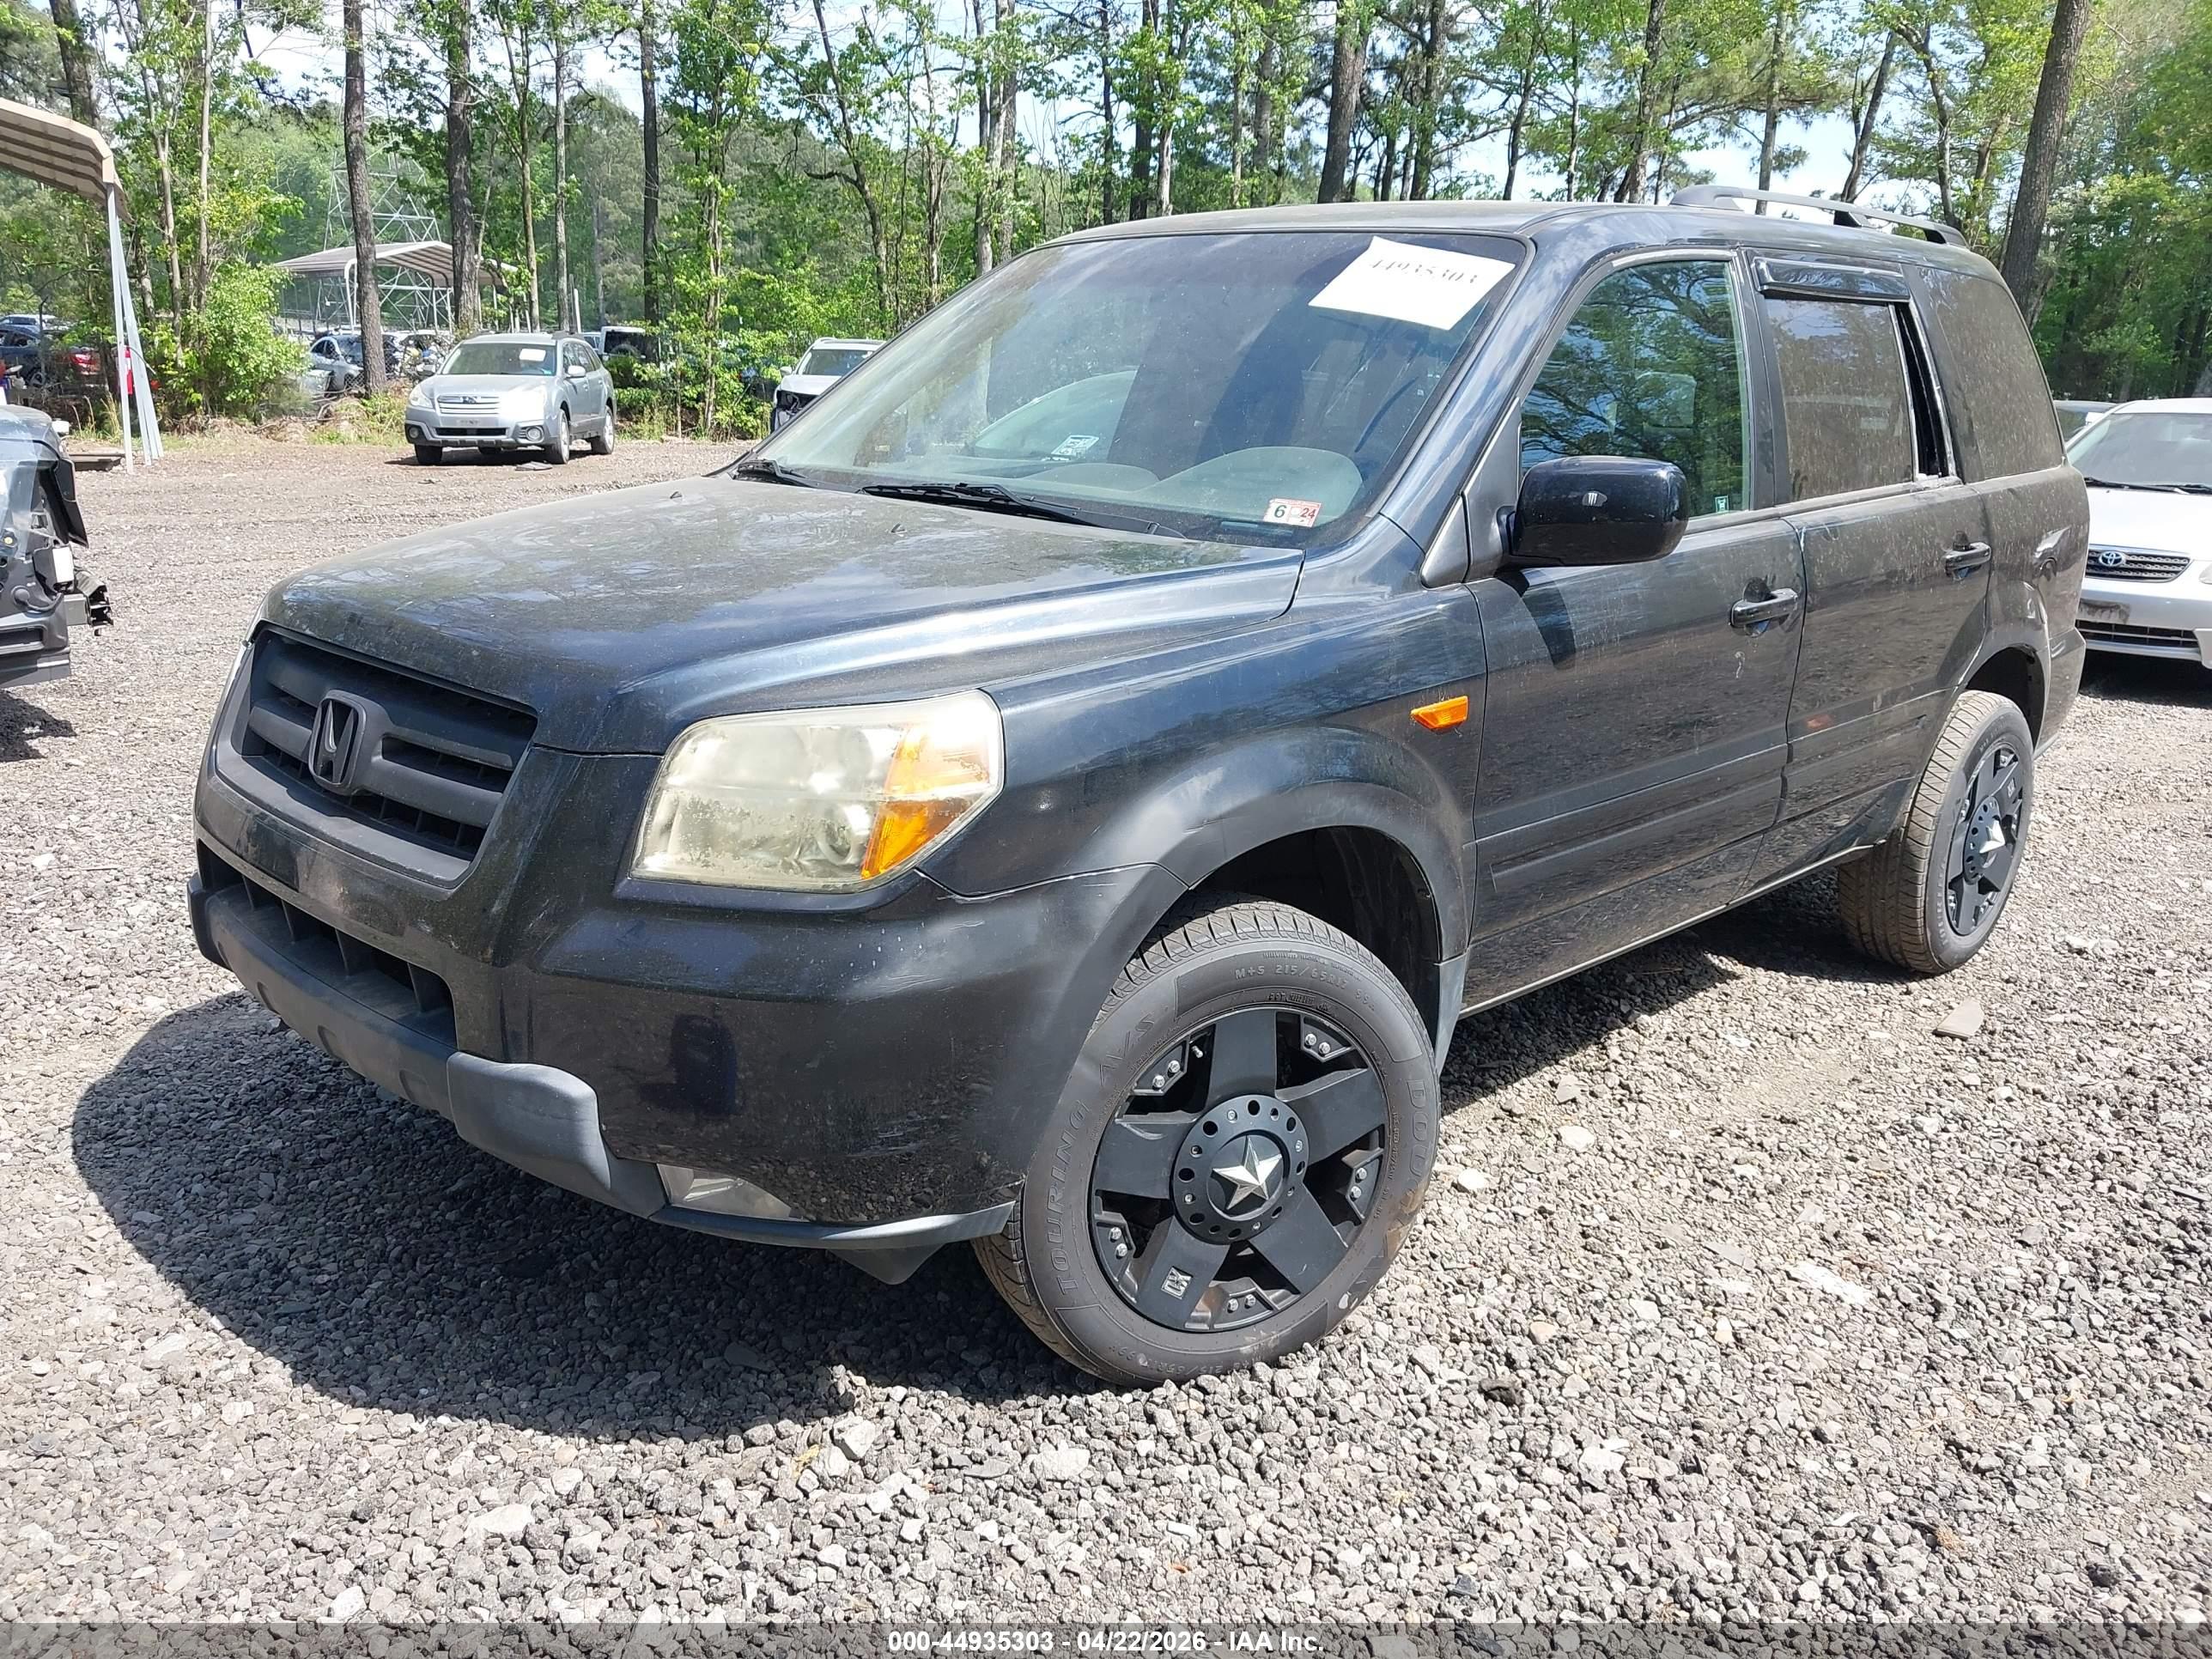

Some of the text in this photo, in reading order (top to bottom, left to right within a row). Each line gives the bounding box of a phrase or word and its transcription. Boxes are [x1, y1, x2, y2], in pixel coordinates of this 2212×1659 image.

[1273, 505, 1316, 520] 6 24
[1047, 1099, 1090, 1296] TOURING
